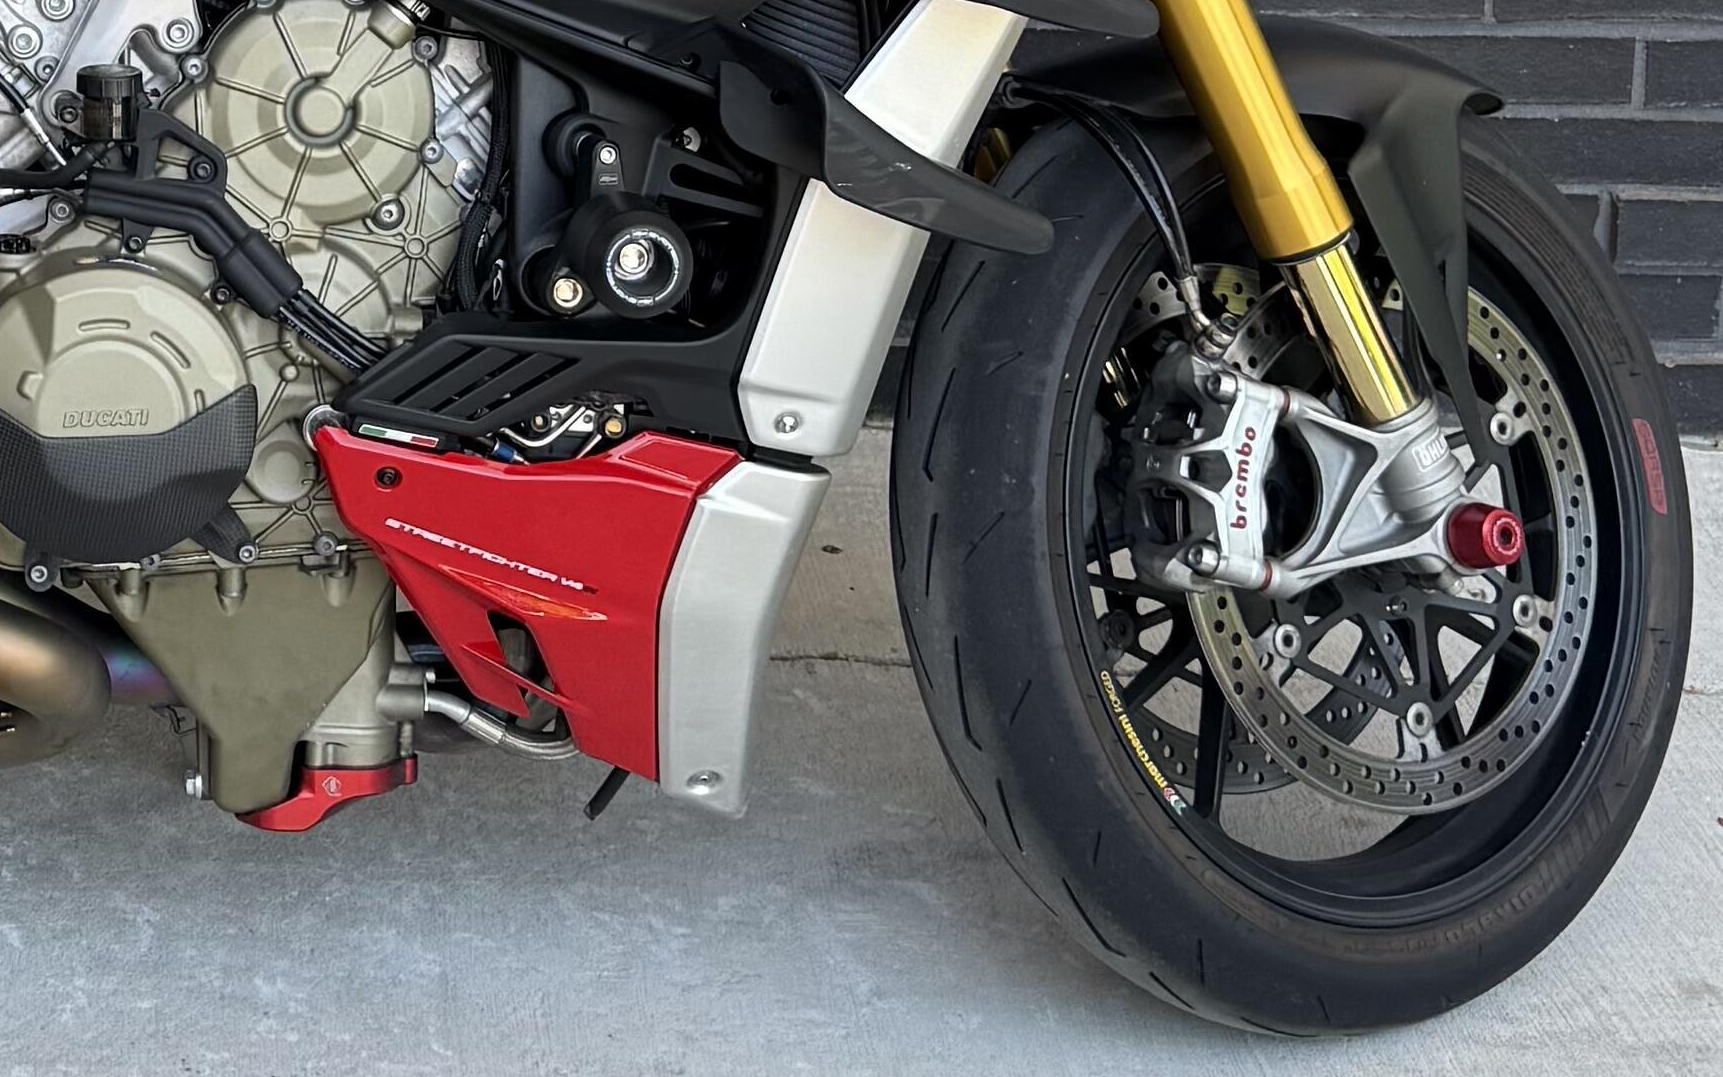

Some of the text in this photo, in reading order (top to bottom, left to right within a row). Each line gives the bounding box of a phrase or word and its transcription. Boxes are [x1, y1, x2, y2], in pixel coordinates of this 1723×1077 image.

[62, 408, 149, 428] DUCATI
[1229, 426, 1256, 529] brembo
[384, 518, 558, 582] STREETFIGHTER
[1100, 670, 1169, 788] marchesini FORGED
